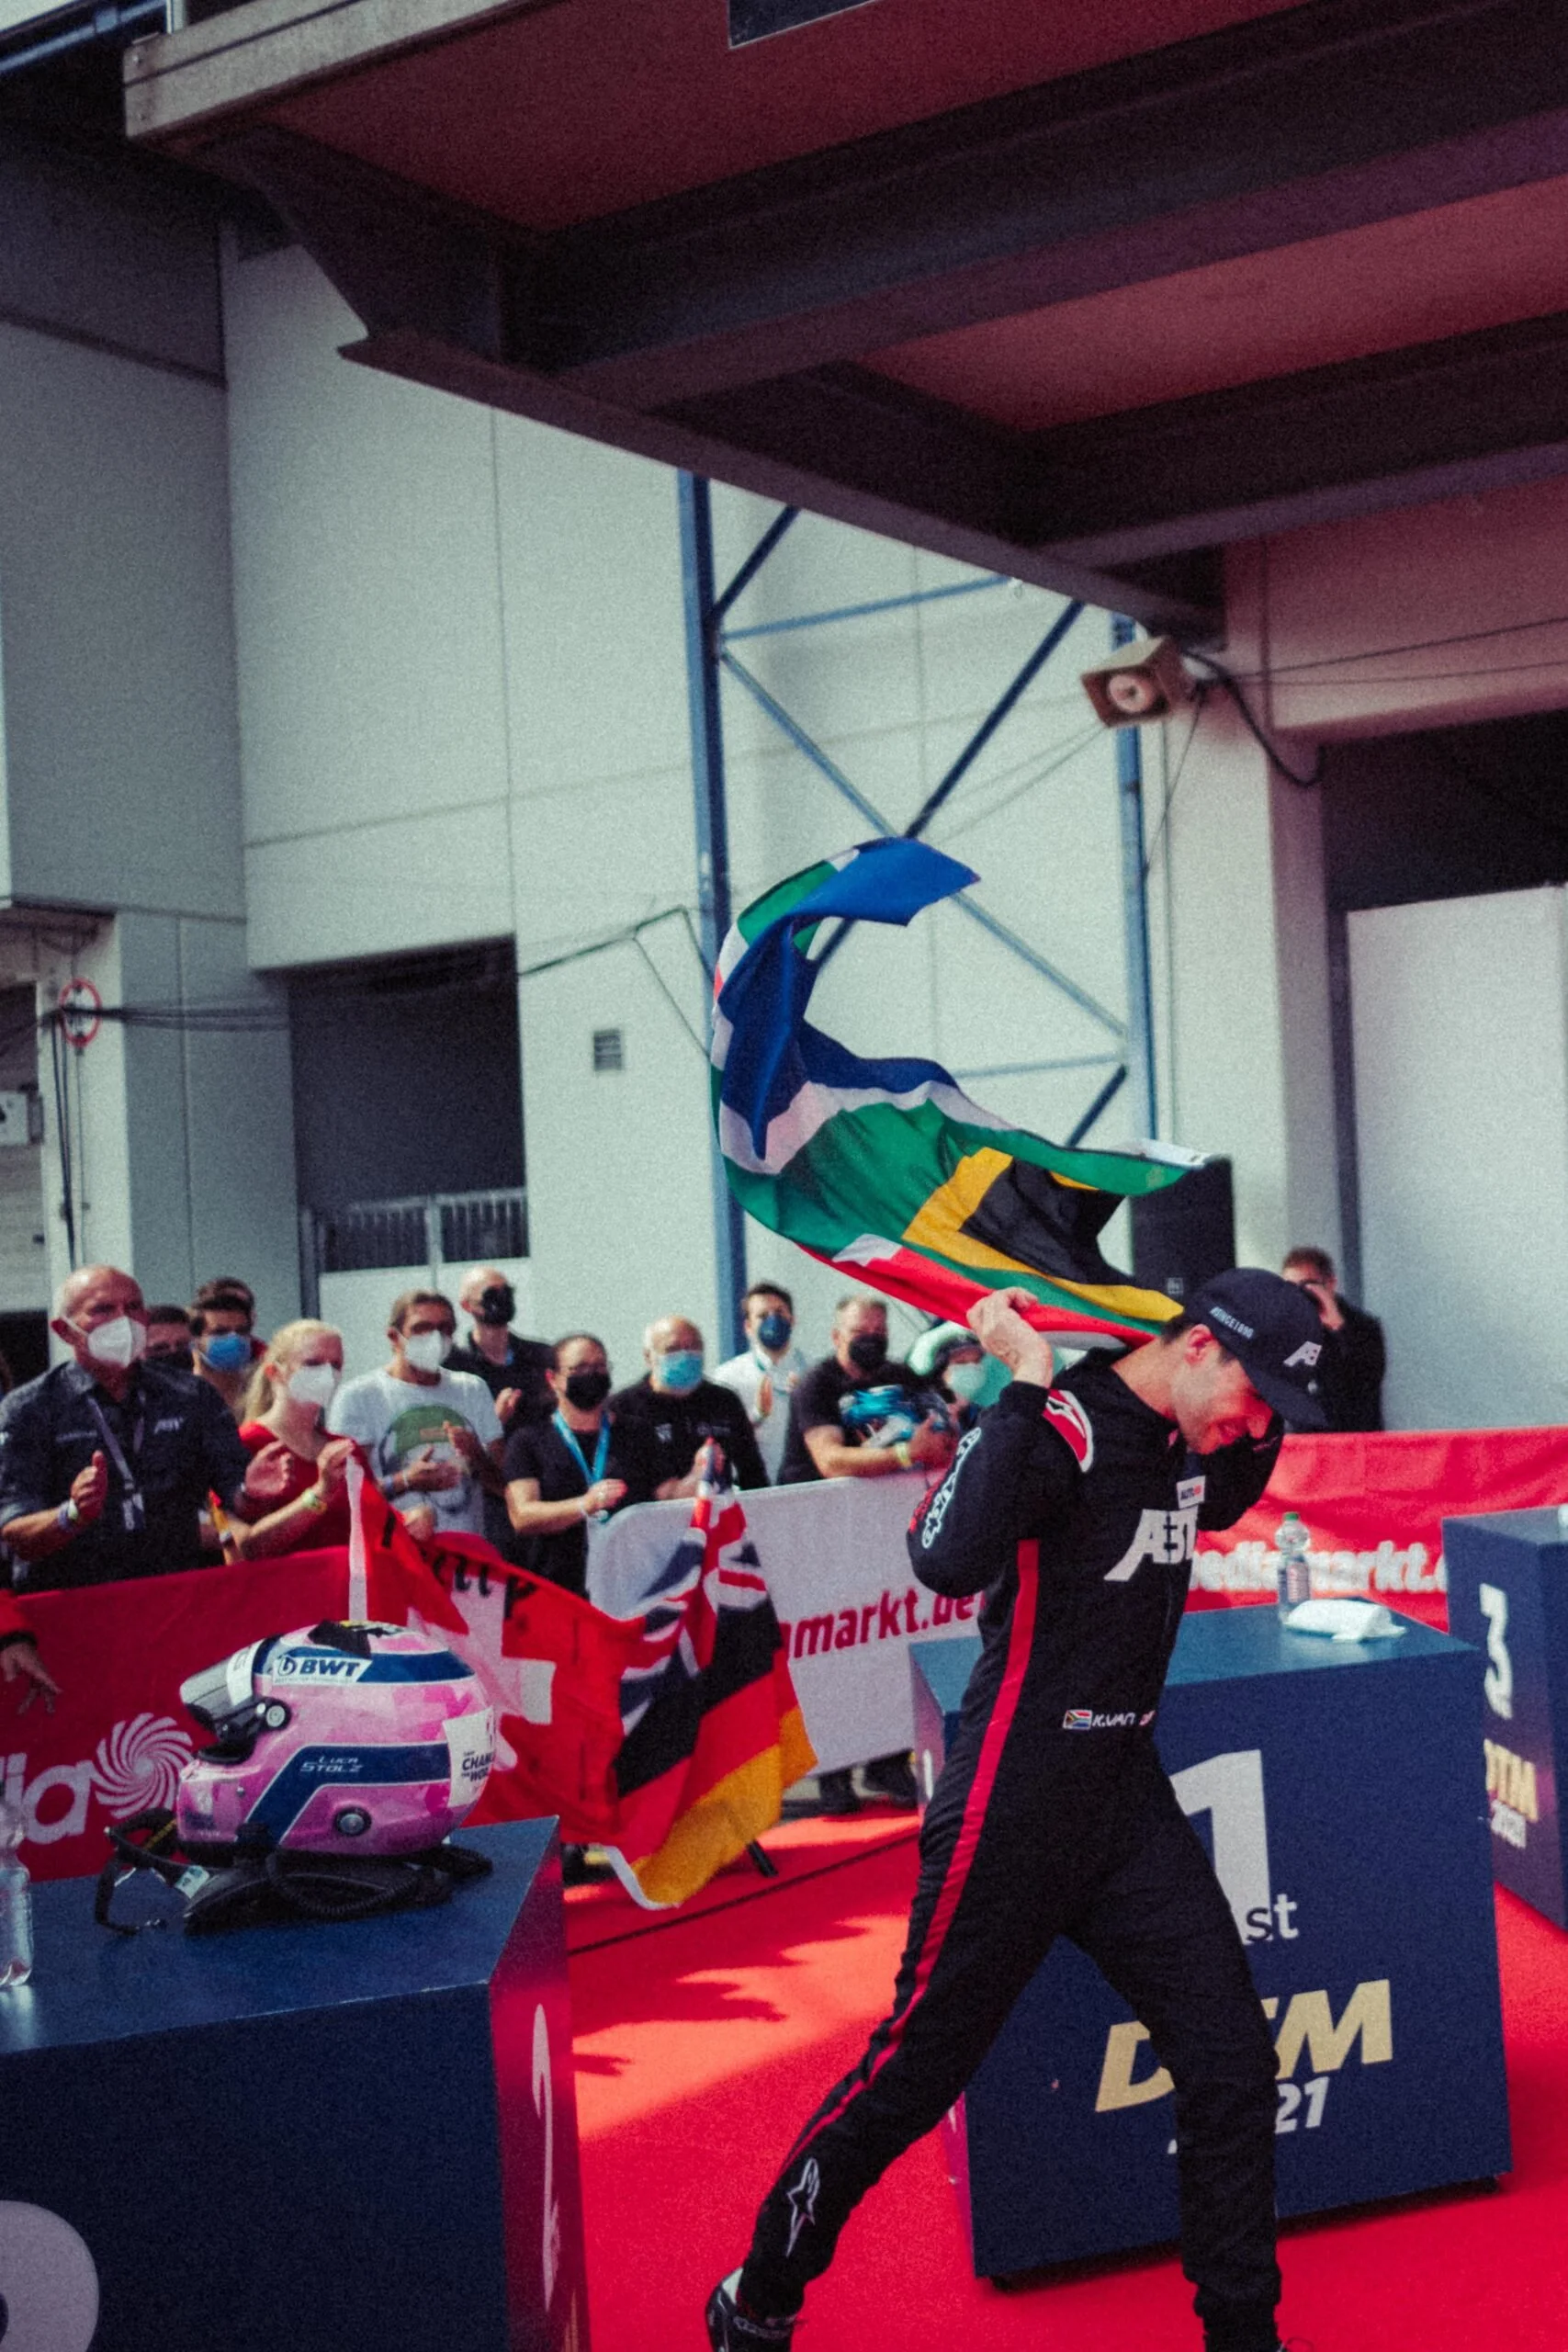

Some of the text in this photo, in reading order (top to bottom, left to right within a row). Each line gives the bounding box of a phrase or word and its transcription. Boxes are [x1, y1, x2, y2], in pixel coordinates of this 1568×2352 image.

[299, 1659, 360, 1677] BWT
[0, 1752, 93, 1845] ia
[1095, 1978, 1393, 2112] DM
